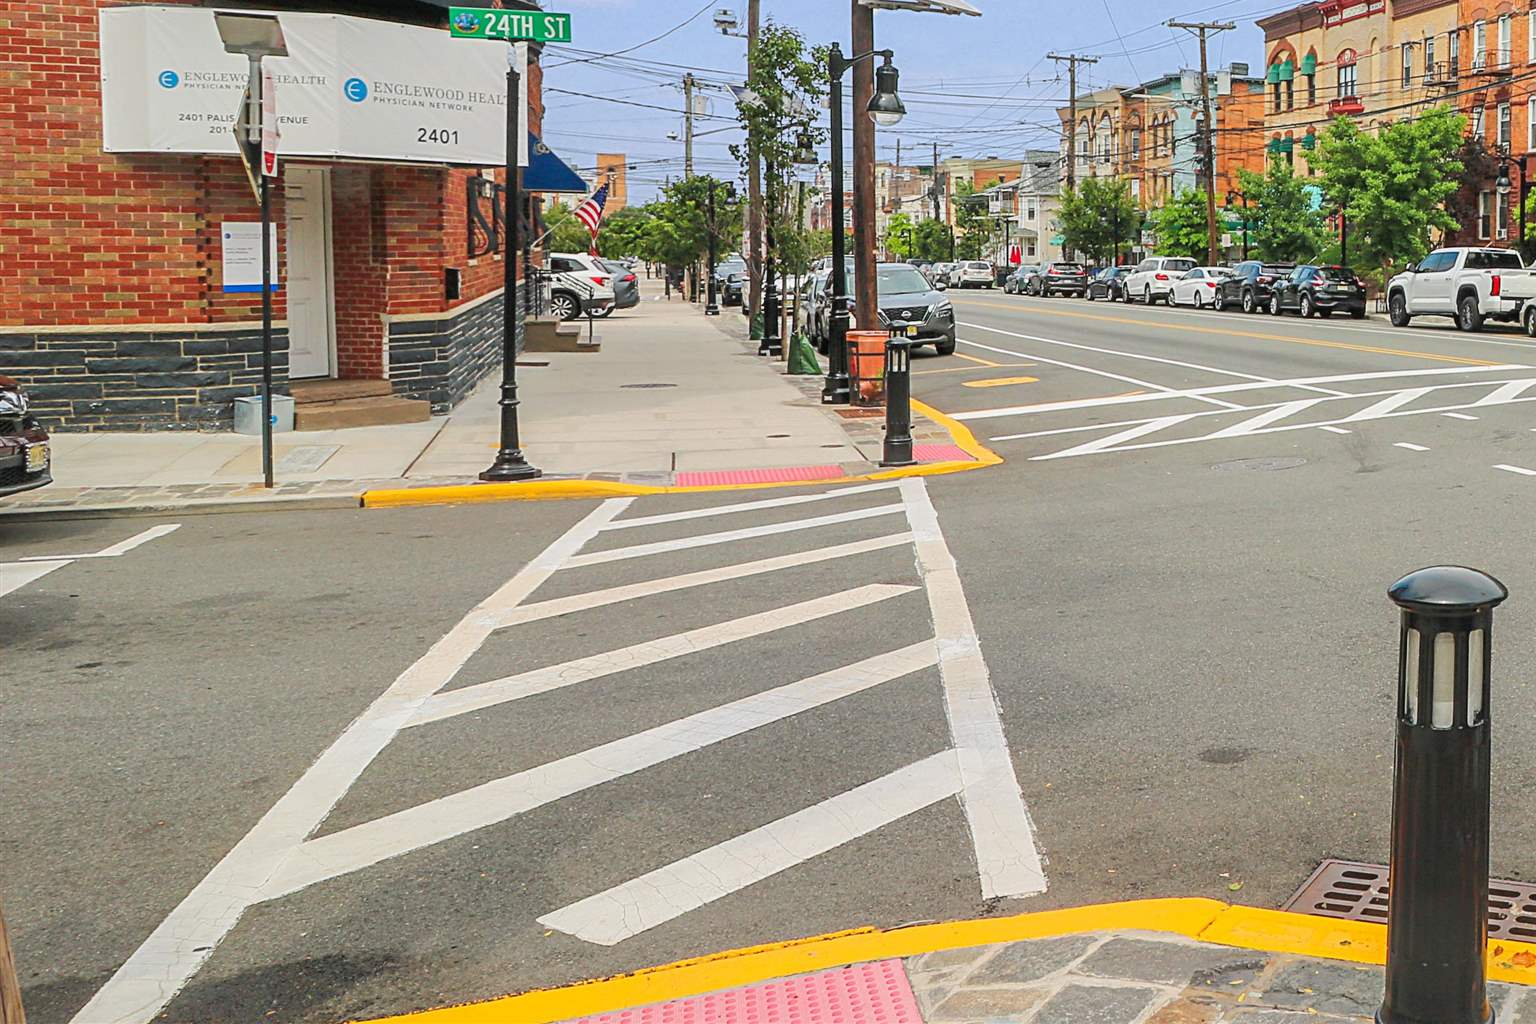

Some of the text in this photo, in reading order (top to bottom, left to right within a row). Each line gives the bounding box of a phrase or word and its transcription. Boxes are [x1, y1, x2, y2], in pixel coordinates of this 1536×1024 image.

[484, 12, 566, 38] 24TH ST
[183, 71, 250, 82] ENGLEWO
[373, 81, 464, 101] ENGLEWOOD
[468, 91, 508, 105] HEAL
[373, 96, 473, 112] PHYSICIAN NETWORK
[178, 113, 309, 125] 2401 PALIS ENUE
[417, 128, 459, 145] 2401
